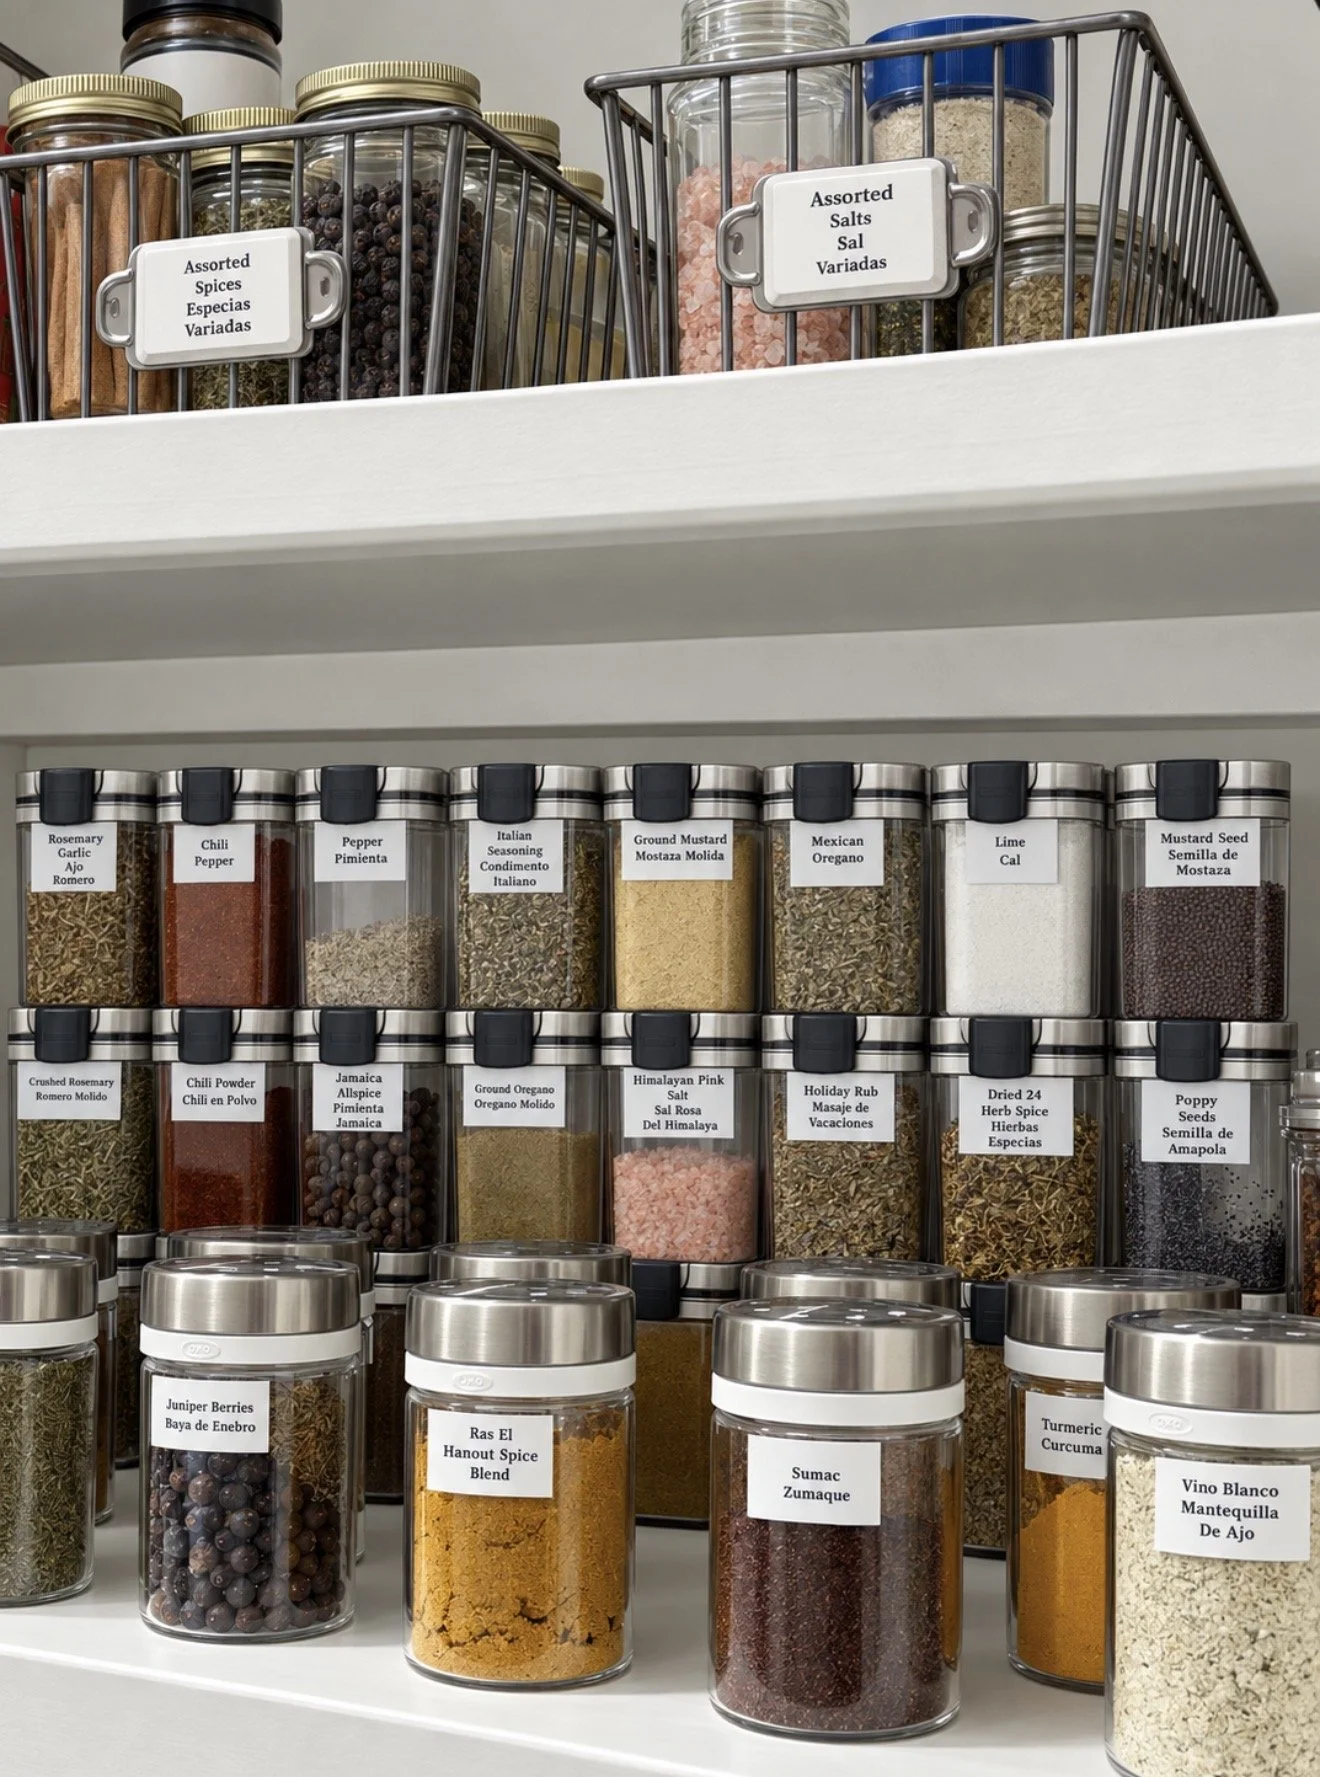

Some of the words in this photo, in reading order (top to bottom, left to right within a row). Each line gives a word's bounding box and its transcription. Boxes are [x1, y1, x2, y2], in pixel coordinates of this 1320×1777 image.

[810, 184, 893, 207] Assorted
[830, 211, 872, 228] Salts
[838, 233, 863, 250] Sal
[184, 253, 250, 274] Assorted
[816, 255, 887, 275] Variadas
[195, 275, 242, 297] Spices
[187, 298, 251, 318] Especias
[185, 318, 251, 337] Variadas
[48, 834, 104, 846] Rosemary
[497, 830, 532, 841] Italian
[634, 834, 676, 845] Ground
[680, 834, 727, 845] Mustard
[812, 835, 864, 847] Mexican
[995, 836, 1026, 847] Lime
[1161, 832, 1213, 844] Mustard
[1218, 832, 1248, 844] Seed
[201, 839, 228, 850] Chili
[342, 837, 383, 850] Pepper
[57, 847, 91, 858] Garlic
[335, 852, 387, 864] Pimienta
[487, 845, 543, 858] Seasoning
[636, 851, 681, 861] Mostaza
[685, 849, 724, 861] Molida
[1168, 848, 1217, 860] Semilla
[1222, 848, 1238, 860] de
[195, 856, 234, 869] Pepper
[812, 852, 864, 865] Oregano
[1000, 854, 1020, 866] Cal
[65, 861, 84, 875] Ajo
[480, 860, 549, 871] Condimento
[1176, 864, 1231, 875] Mostaza
[53, 875, 95, 885] Romero
[494, 876, 537, 886] Italiano
[29, 1077, 66, 1086] Crushed
[69, 1077, 115, 1089] Rosemary
[186, 1077, 212, 1088] Chili
[216, 1077, 256, 1088] Powder
[335, 1072, 382, 1083] Jamaica
[633, 1074, 694, 1088] Himalayan
[698, 1074, 724, 1085] Pink
[36, 1091, 72, 1101] Romero
[75, 1092, 108, 1101] Molido
[474, 1084, 511, 1094] Ground
[513, 1084, 555, 1096] Oregano
[667, 1090, 688, 1100] Salt
[804, 1085, 850, 1099] Holiday
[855, 1086, 878, 1097] Rub
[988, 1089, 1022, 1100] Dried
[1026, 1089, 1041, 1100] 24
[182, 1094, 207, 1105] Chili
[210, 1094, 224, 1105] en
[227, 1094, 257, 1105] Polvo
[474, 1099, 517, 1111] Oregano
[520, 1099, 555, 1109] Molido
[1176, 1094, 1218, 1109] Poppy
[654, 1105, 672, 1115] Sal
[675, 1105, 702, 1115] Rosa
[812, 1101, 852, 1115] Masaje
[855, 1102, 869, 1113] de
[981, 1105, 1012, 1116] Herb
[1015, 1105, 1049, 1119] Spice
[336, 1117, 382, 1128] Jamaica
[1179, 1110, 1216, 1122] Seeds
[643, 1119, 661, 1130] Del
[665, 1120, 718, 1133] Himalaya
[991, 1121, 1039, 1132] Hierbas
[1162, 1126, 1211, 1138] Semilla
[1217, 1127, 1233, 1139] de
[988, 1136, 1042, 1150] Especias
[1168, 1143, 1226, 1157] Amapola
[166, 1398, 208, 1414] Juniper
[211, 1401, 254, 1413] Berries
[165, 1417, 191, 1432] Baya
[195, 1419, 209, 1431] de
[213, 1420, 256, 1433] Enebro
[1041, 1417, 1102, 1436] Turmeric
[470, 1427, 494, 1440] Ras
[499, 1428, 512, 1441] El
[1041, 1437, 1103, 1455] Curcuma
[444, 1445, 494, 1460] Hanout
[499, 1448, 538, 1465] Spice
[470, 1466, 510, 1481] Blend
[792, 1467, 840, 1482] Sumac
[1182, 1479, 1218, 1494] Vino
[1223, 1482, 1279, 1497] Blanco
[784, 1486, 850, 1504] Zumaque
[1182, 1500, 1279, 1522] Mantequilla
[1200, 1523, 1221, 1538] De
[1226, 1526, 1255, 1543] Ajo
